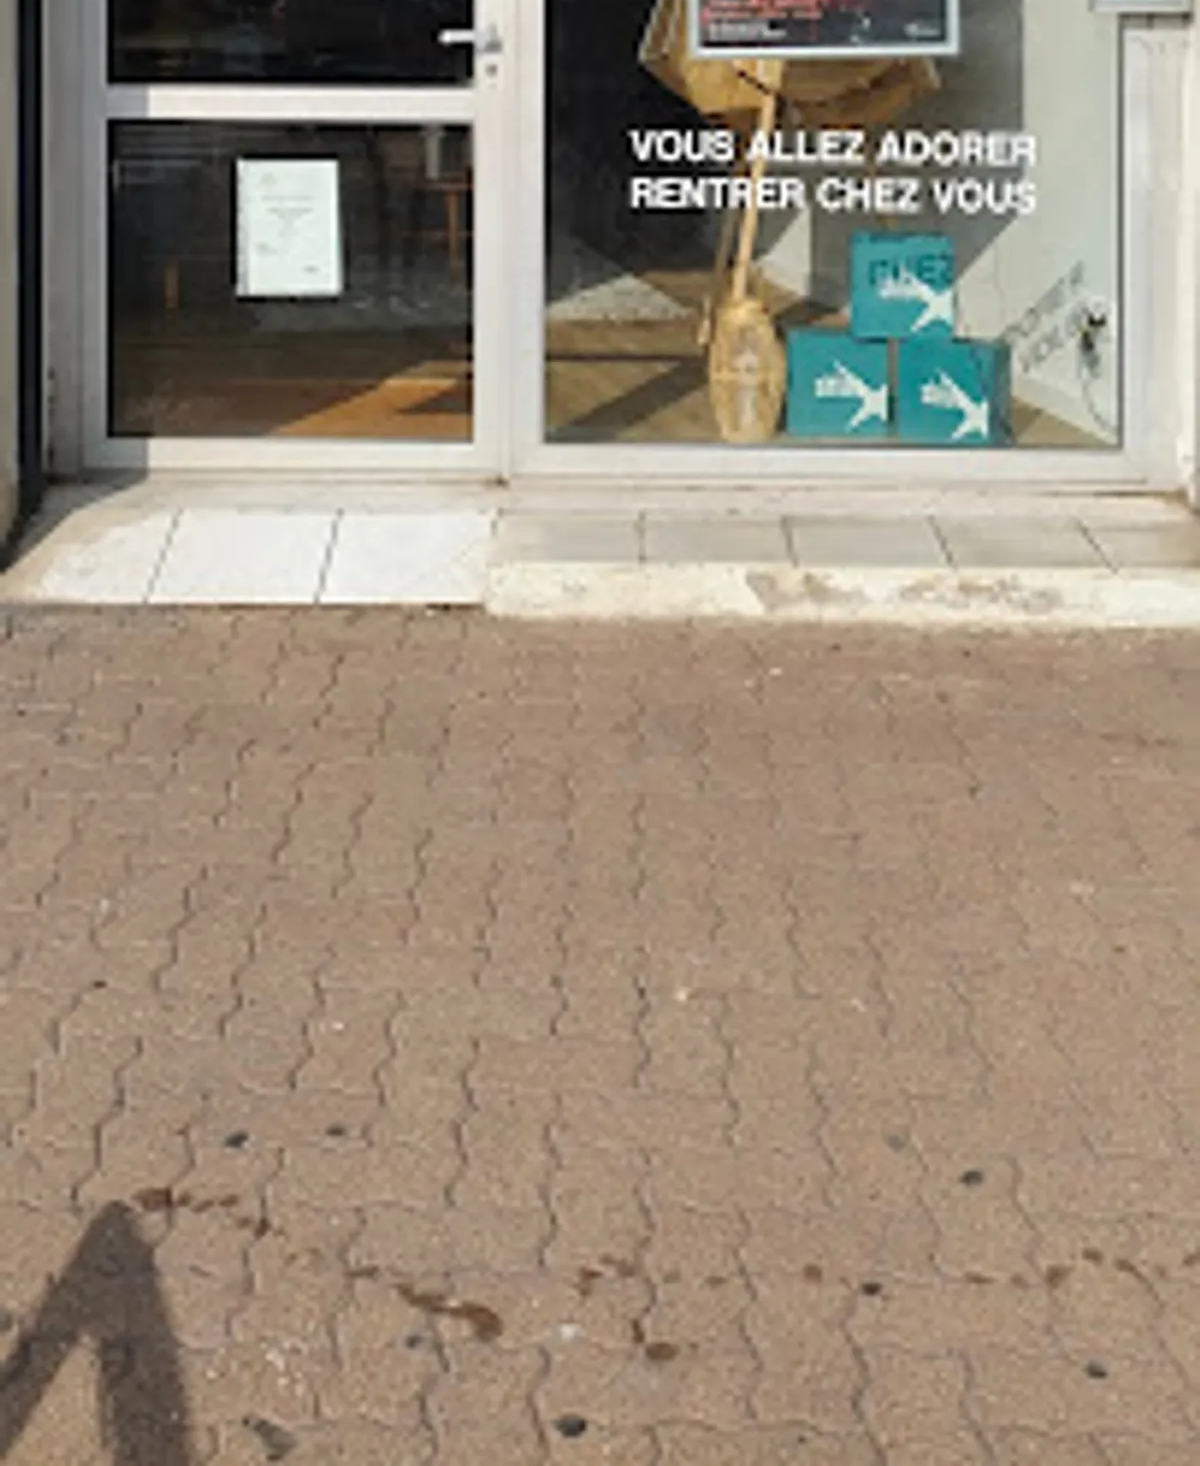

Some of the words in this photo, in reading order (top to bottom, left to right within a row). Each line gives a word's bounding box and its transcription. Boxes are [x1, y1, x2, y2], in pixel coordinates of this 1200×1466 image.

[629, 129, 734, 162] VOUS
[746, 130, 865, 162] ALLEZ
[876, 129, 1037, 167] ADORER
[630, 177, 807, 210] RENTRER
[815, 177, 920, 214] CHEZ
[932, 177, 1037, 215] VOUS
